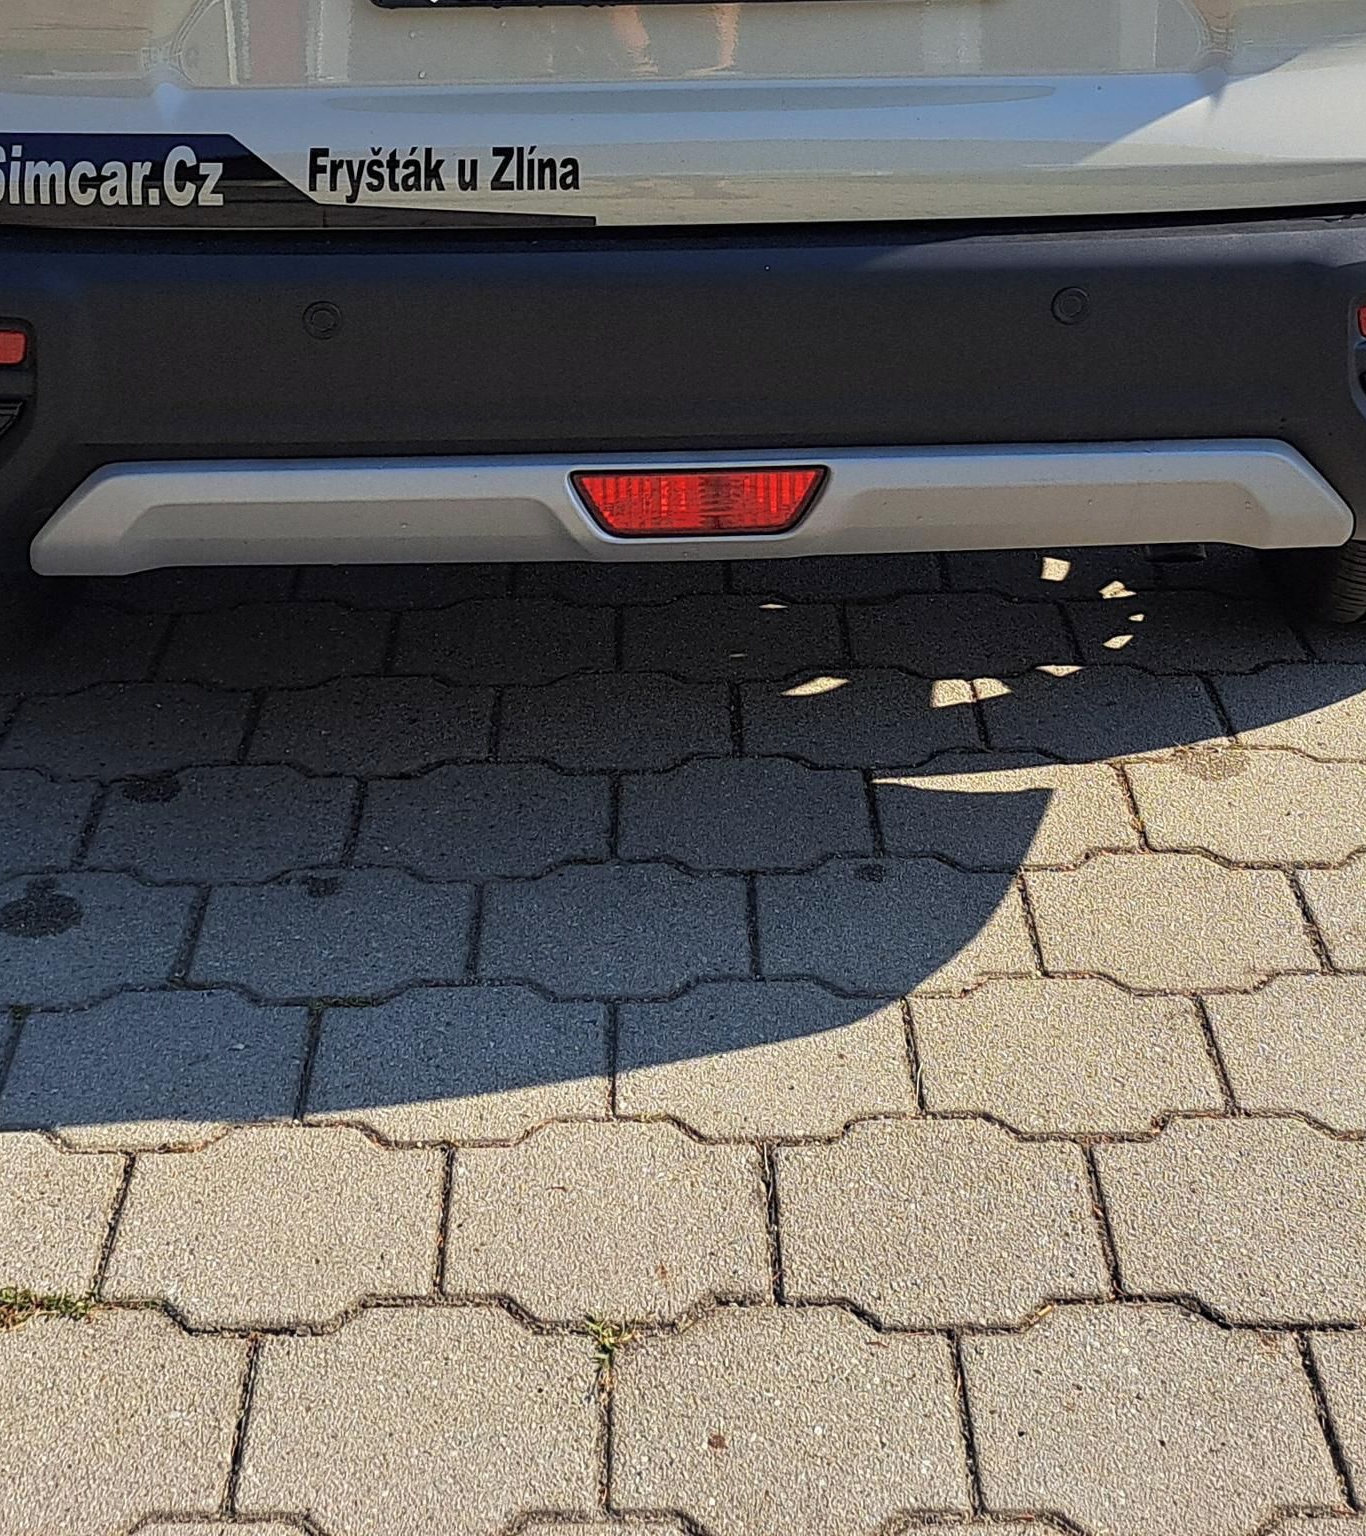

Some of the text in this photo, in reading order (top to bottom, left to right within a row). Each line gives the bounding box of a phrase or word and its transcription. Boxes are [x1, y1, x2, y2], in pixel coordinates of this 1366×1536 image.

[308, 145, 581, 204] Fryšták u Zlína
